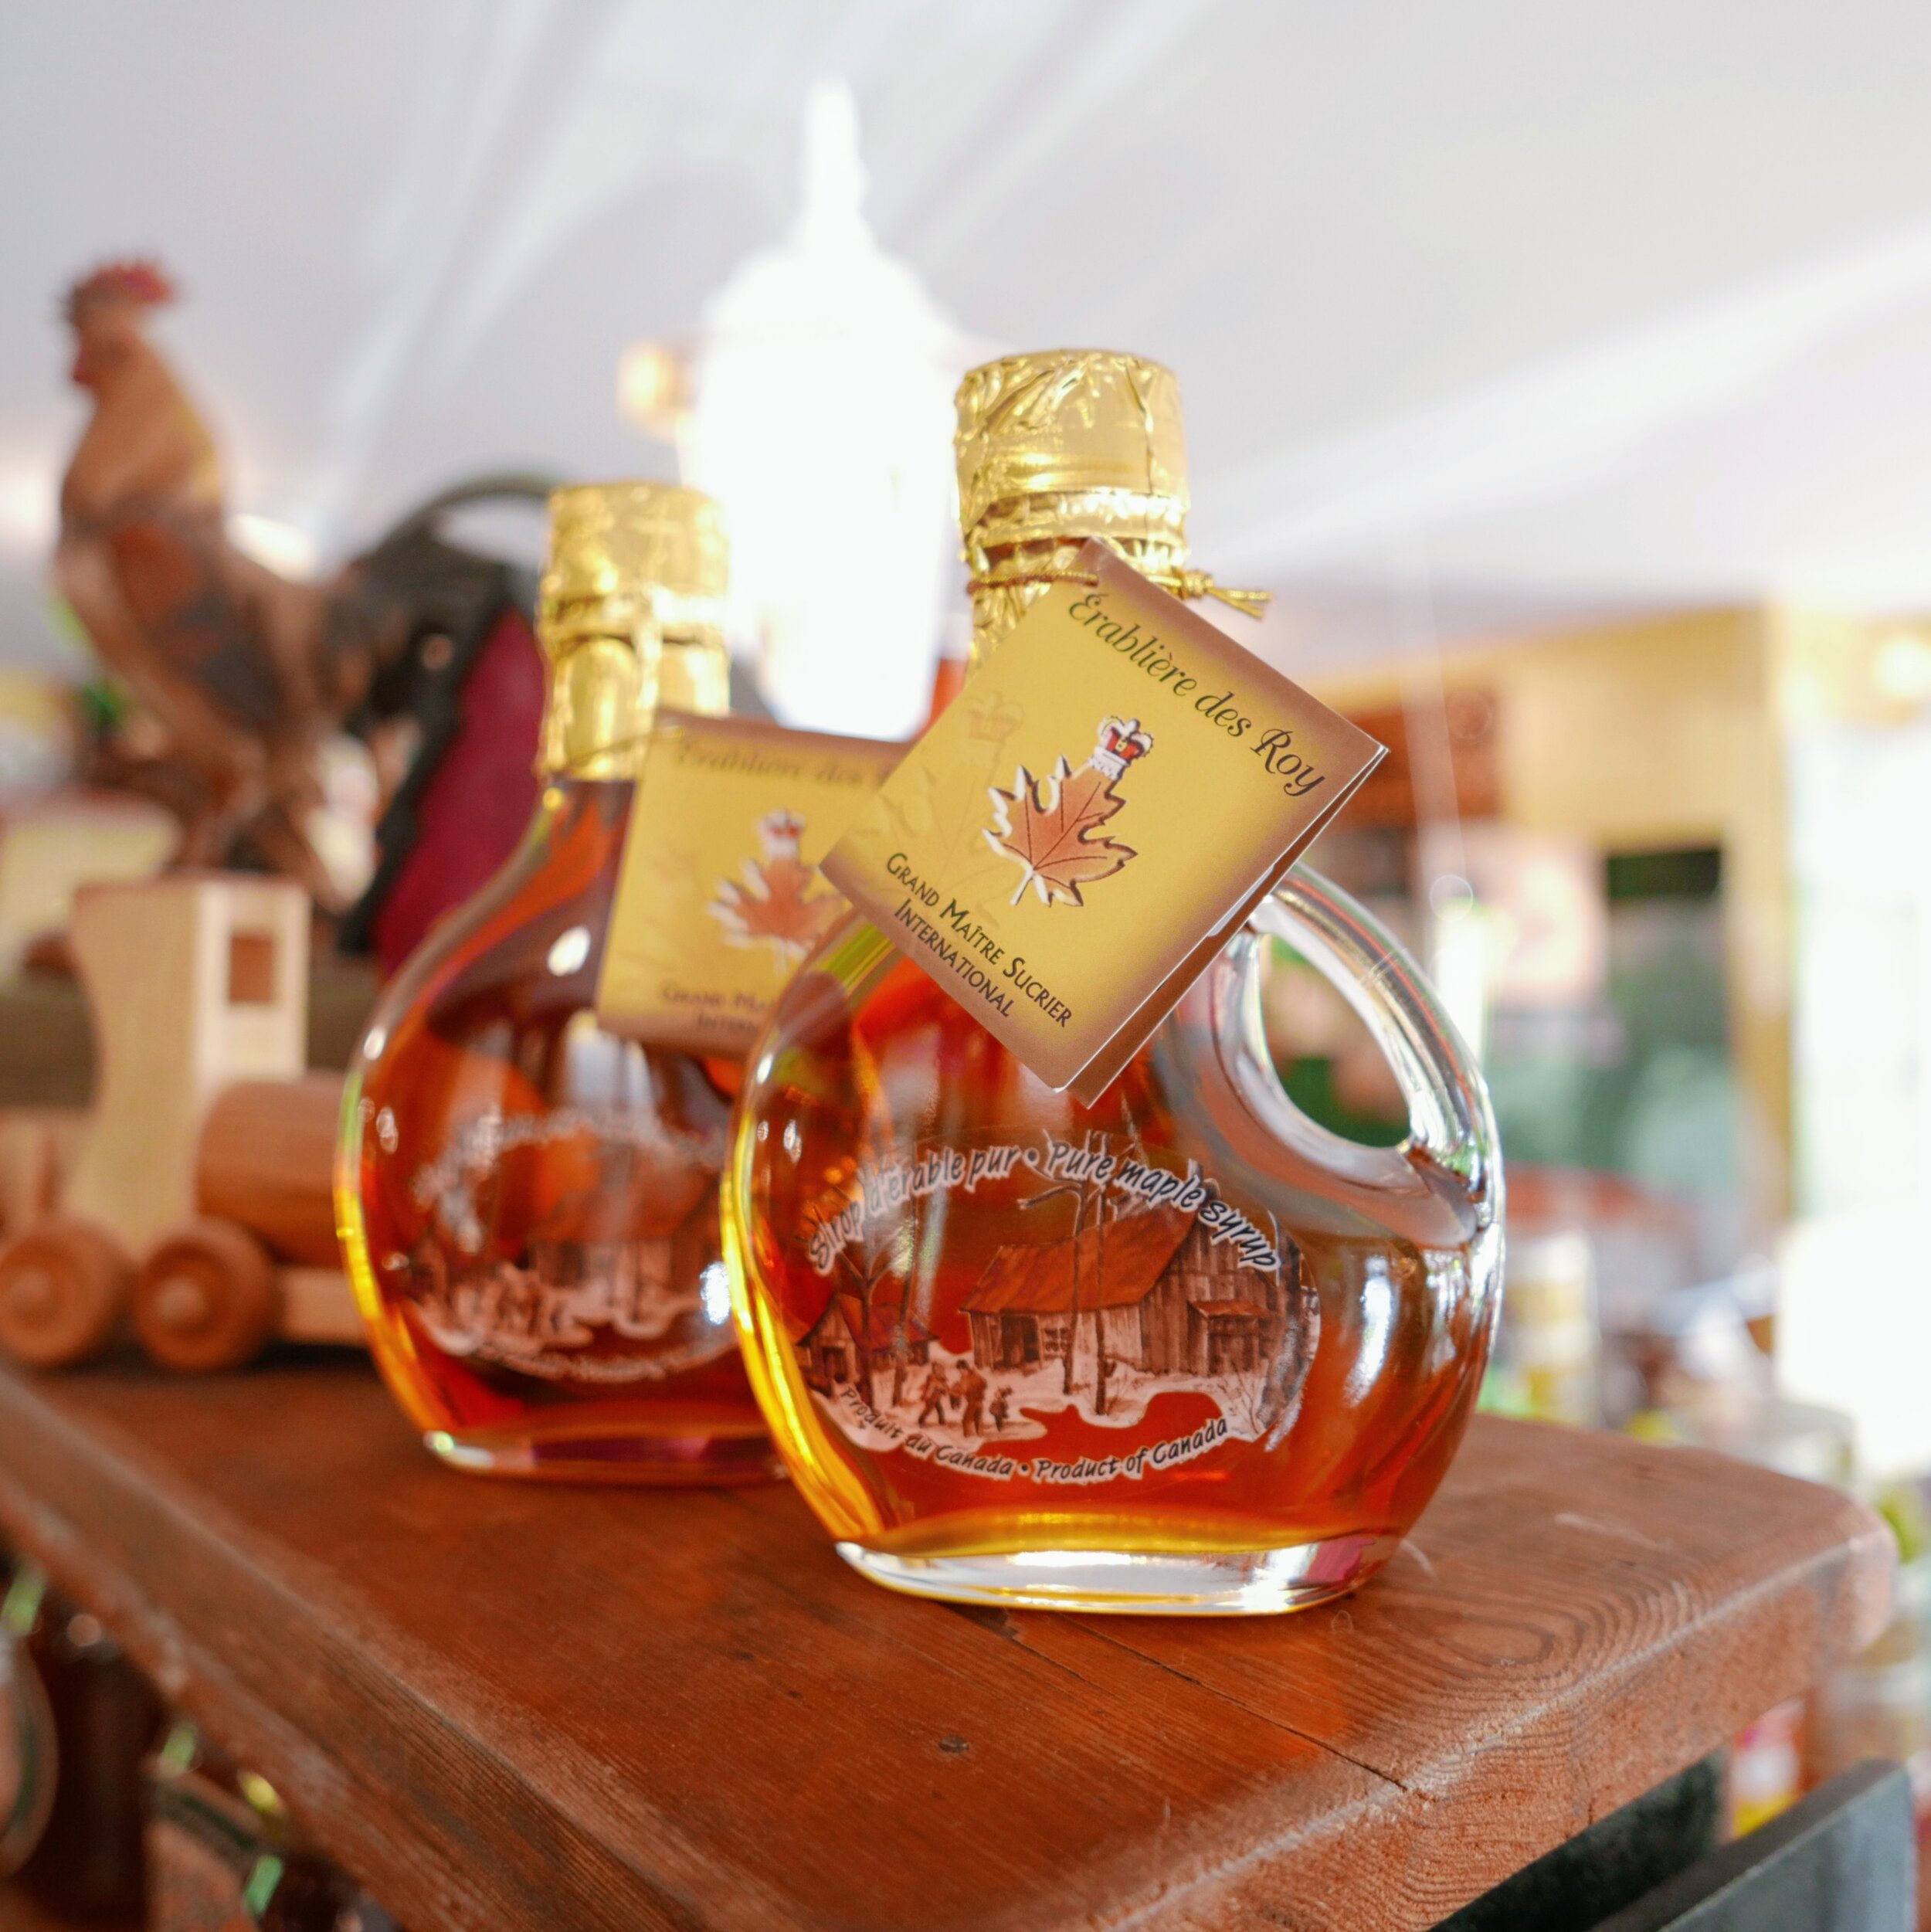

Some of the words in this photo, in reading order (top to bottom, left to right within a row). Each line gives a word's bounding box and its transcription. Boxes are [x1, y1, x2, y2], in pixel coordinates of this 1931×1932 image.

[1068, 593, 1198, 696] Érablière
[1194, 691, 1252, 737] des
[1249, 728, 1325, 796] Roy
[887, 853, 939, 907] GRAND
[939, 898, 1005, 965] MAÎTRE
[1002, 957, 1072, 1027] SUCRIER
[894, 898, 1014, 1017] INTERNATIONAL
[966, 1145, 1020, 1190] pur
[1047, 1142, 1115, 1180] Pure
[1120, 1161, 1202, 1208] maple
[1200, 1200, 1278, 1268] syrup
[840, 1387, 902, 1438] Produit
[905, 1431, 932, 1454] du
[935, 1445, 1014, 1476] Canada
[1035, 1455, 1120, 1480] Product
[1125, 1446, 1149, 1474] of
[1152, 1418, 1228, 1465] Canada
